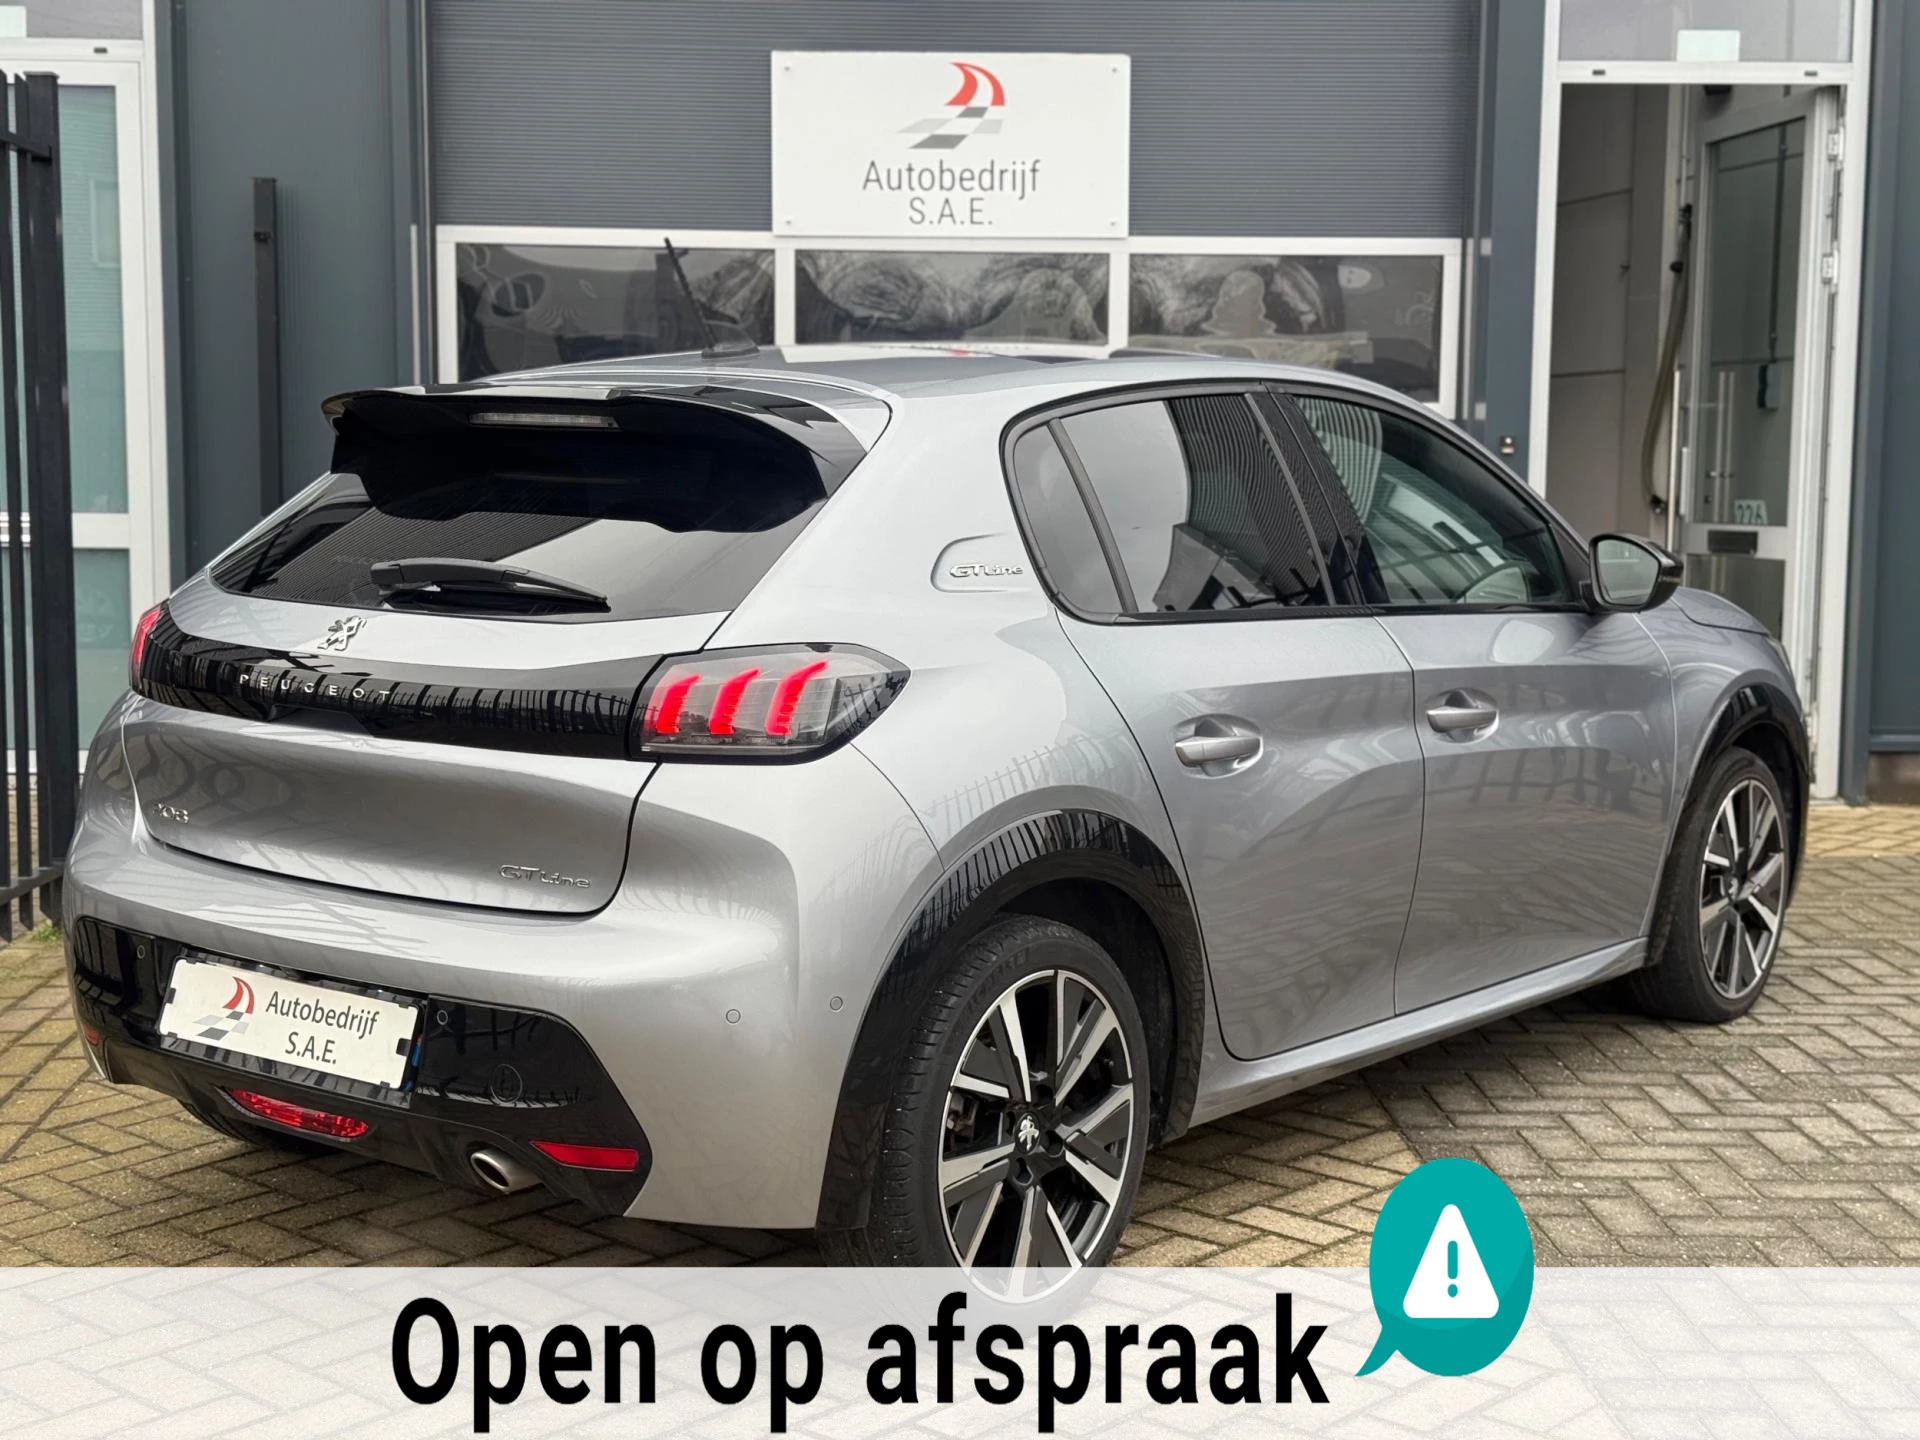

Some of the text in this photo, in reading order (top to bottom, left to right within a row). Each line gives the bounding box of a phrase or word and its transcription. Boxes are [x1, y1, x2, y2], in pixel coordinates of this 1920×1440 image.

[862, 159, 1040, 201] Autobedrijf
[909, 197, 993, 225] S.A.E.
[949, 563, 984, 578] GT
[239, 674, 390, 701] PEUGEOT
[500, 864, 540, 881] GT
[265, 991, 380, 1039] Autobedrijf
[285, 1031, 337, 1065] S.A.E.
